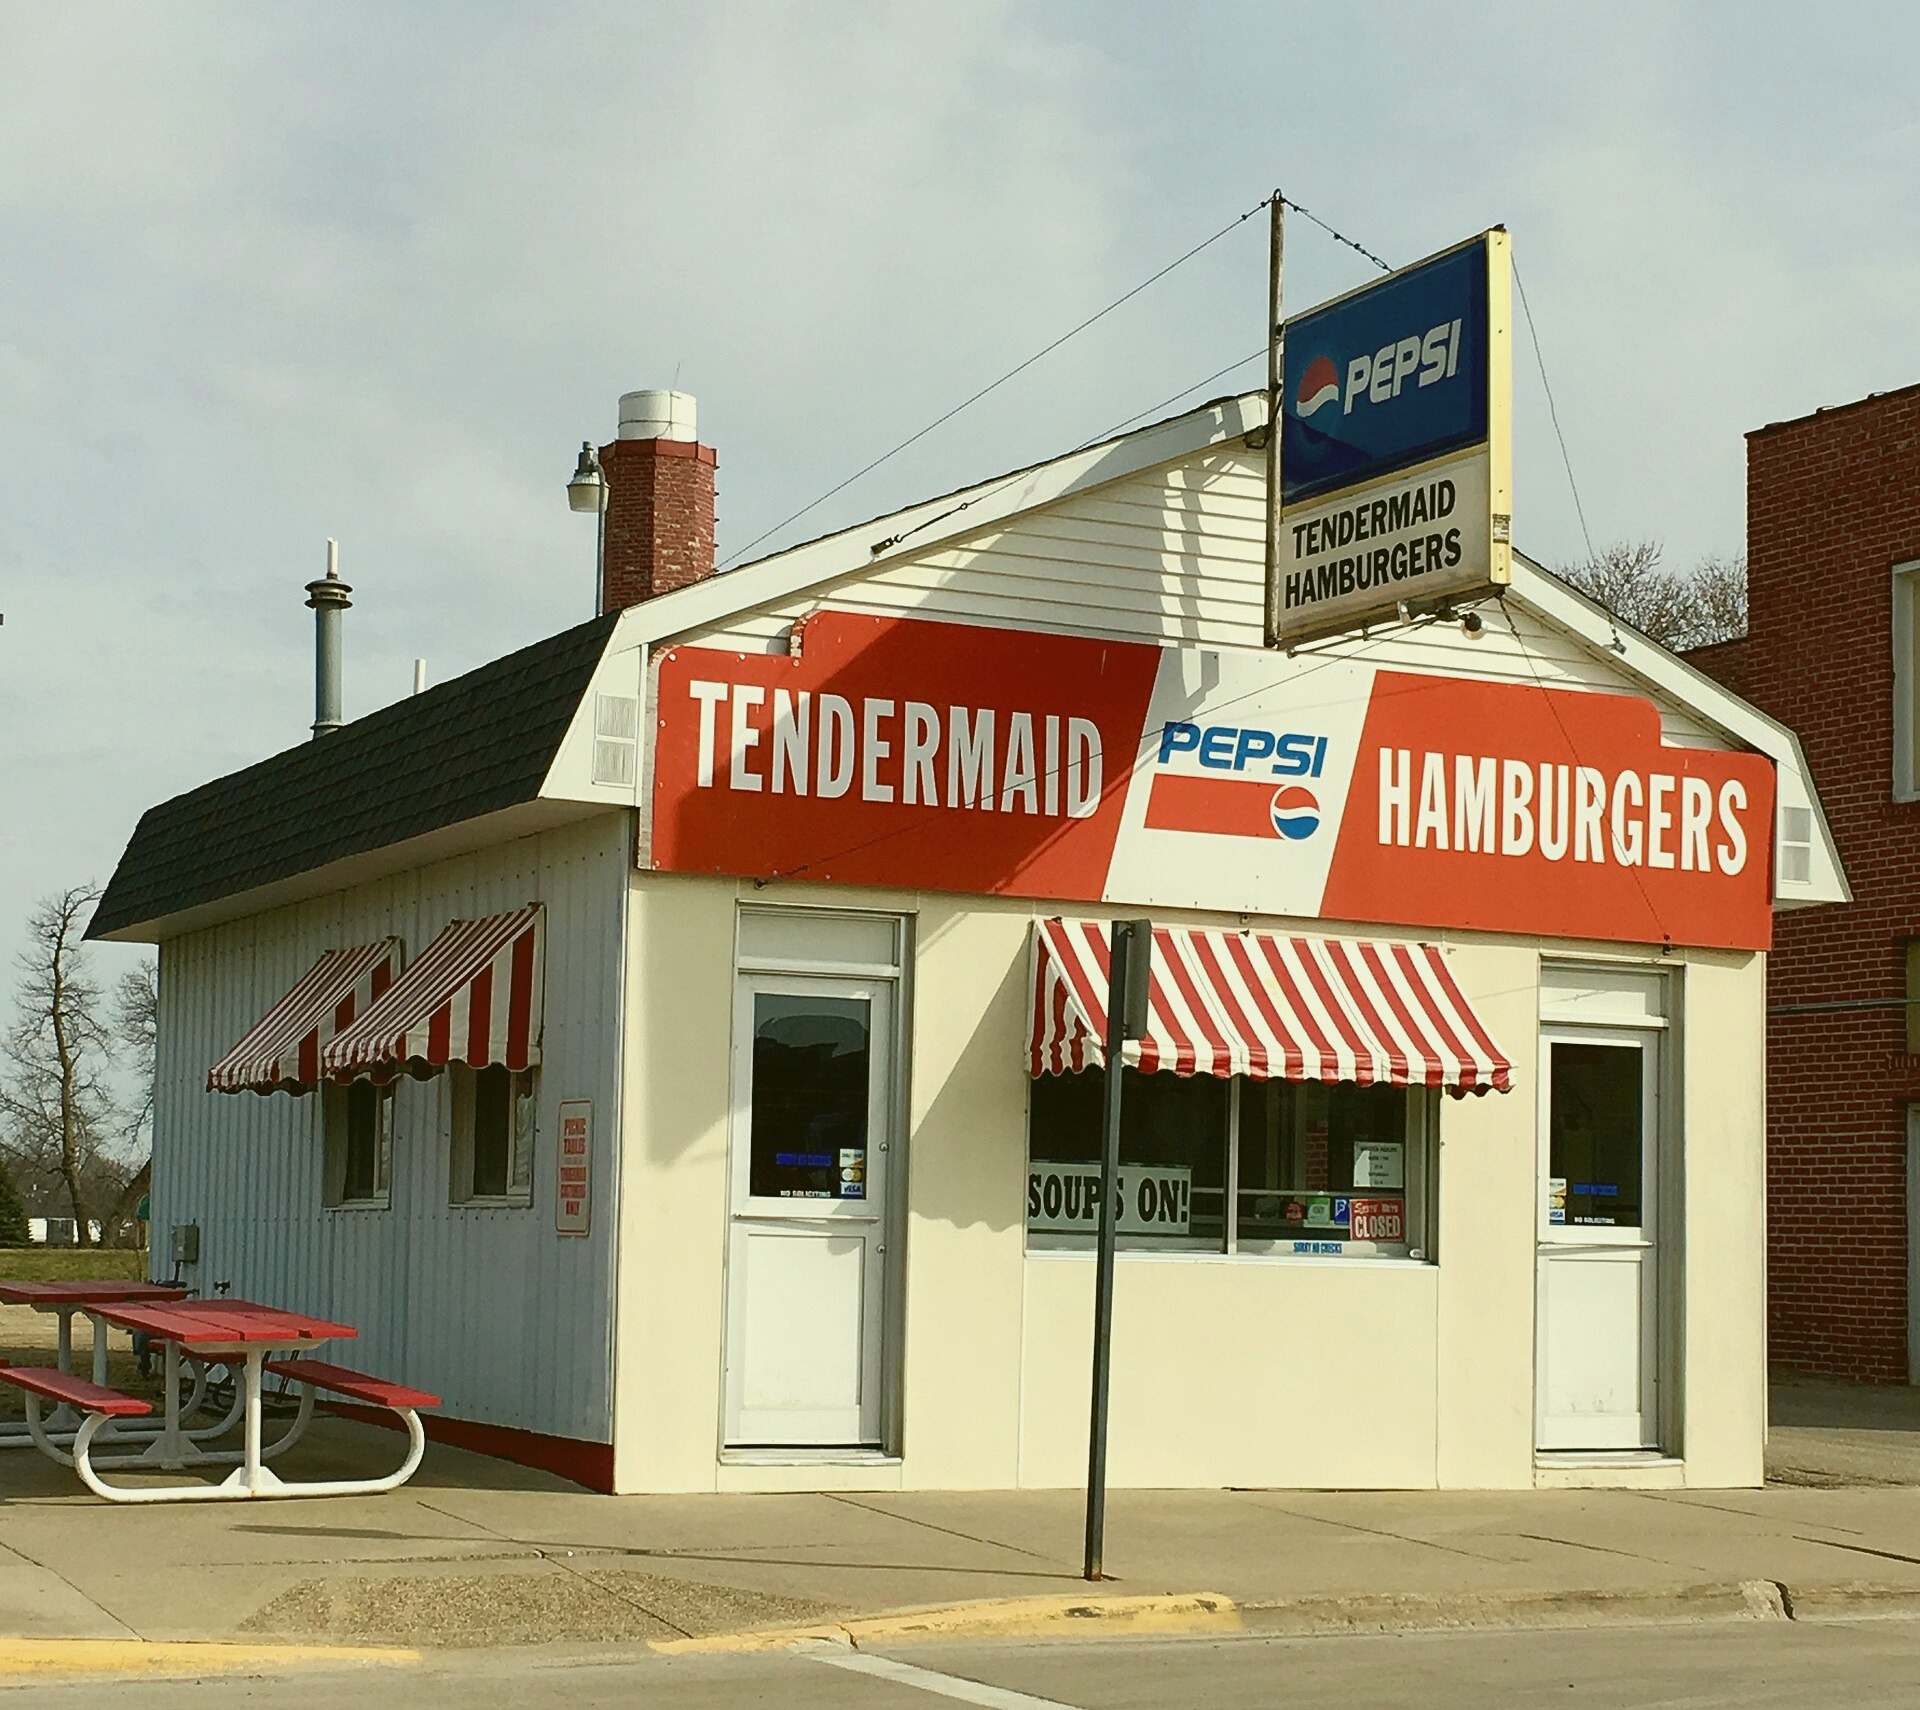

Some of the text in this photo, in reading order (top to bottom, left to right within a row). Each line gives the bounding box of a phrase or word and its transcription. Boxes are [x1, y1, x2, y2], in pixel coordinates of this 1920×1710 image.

[1343, 318, 1462, 416] PEPSI
[1292, 479, 1456, 560] TENDERMAID
[1284, 528, 1462, 609] HAMBURGERS
[688, 680, 1104, 819] TENDERMAID
[1157, 721, 1328, 778] PEPSI
[1378, 746, 1748, 876] HAMBURGERS
[1137, 1177, 1189, 1224] ON!
[1355, 1215, 1400, 1238] CLOSED
